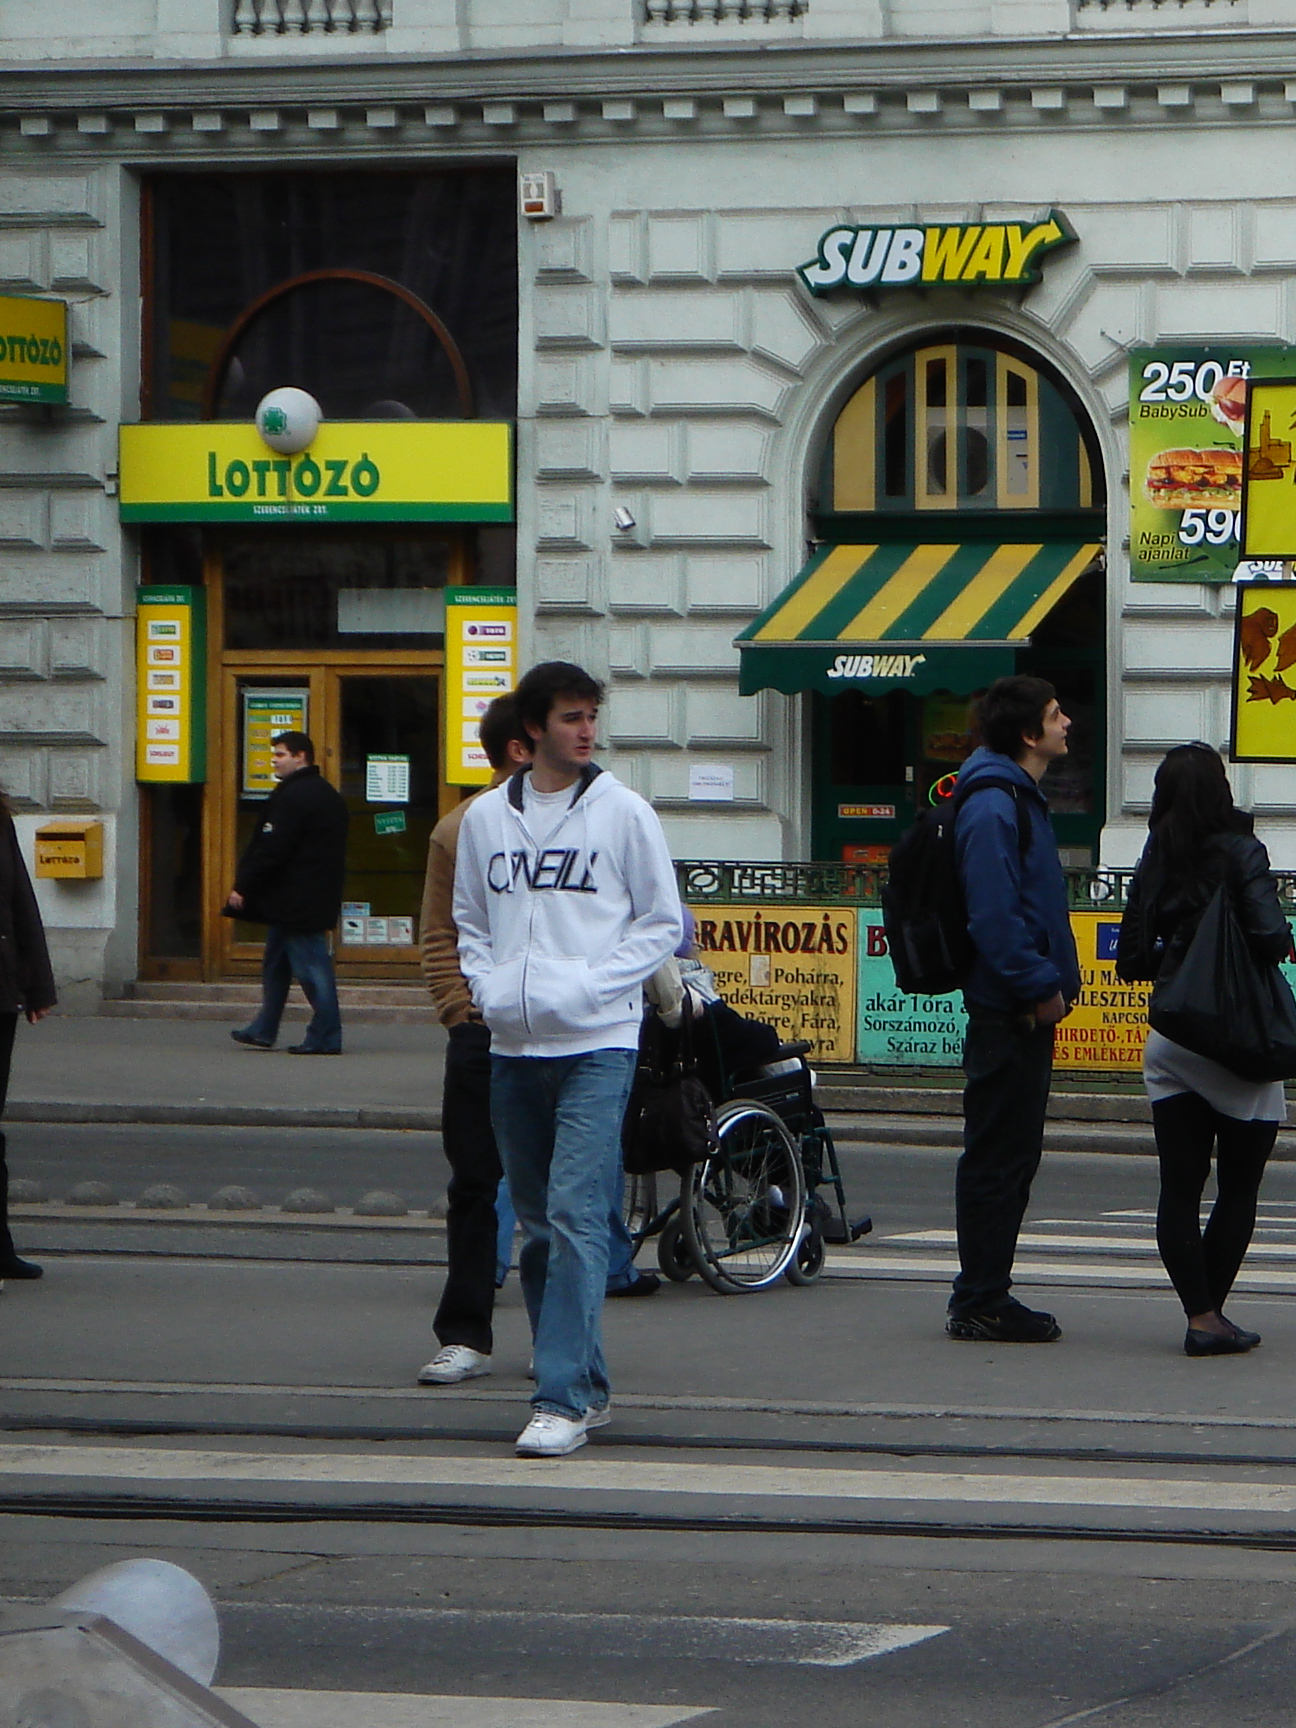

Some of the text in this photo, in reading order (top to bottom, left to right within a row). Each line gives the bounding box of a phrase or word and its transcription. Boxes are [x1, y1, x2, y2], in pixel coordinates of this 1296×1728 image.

[802, 219, 1062, 288] SUBWAY
[1140, 404, 1208, 420] BabySub
[208, 451, 380, 498] LOTTÓZÓ
[1140, 508, 1241, 547] Napi 59
[1138, 546, 1191, 562] ajánlat
[826, 653, 926, 678] SUBWAY
[695, 911, 849, 955] RAVÍROZÁS
[774, 967, 844, 989] Pohárra,
[714, 987, 836, 1012] ndéktárgyakra
[866, 993, 906, 1013] akár
[802, 1012, 841, 1032] Fára,
[864, 1015, 960, 1035] Sorszámozó,
[887, 1037, 937, 1054] Száraz
